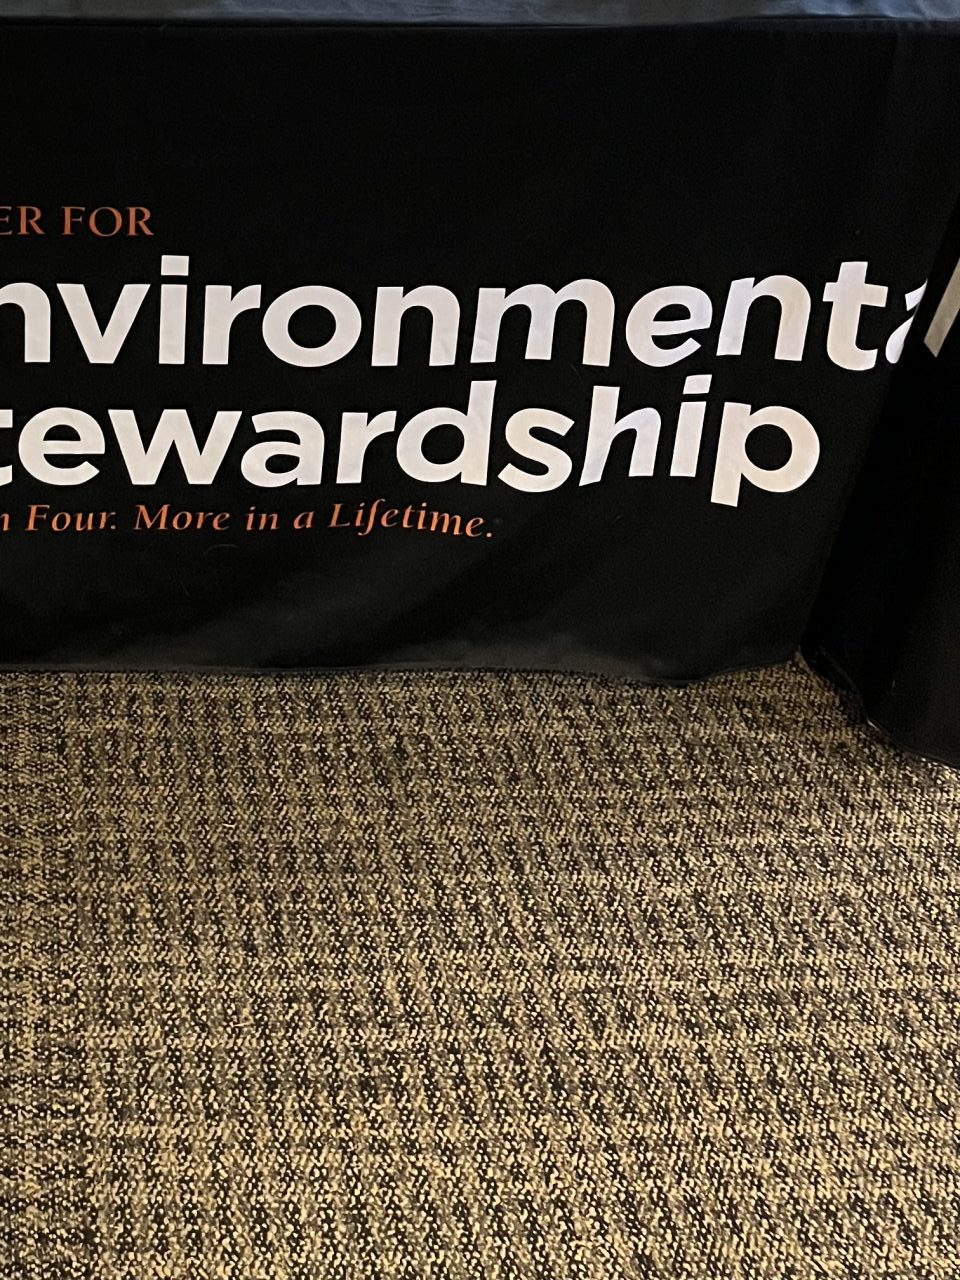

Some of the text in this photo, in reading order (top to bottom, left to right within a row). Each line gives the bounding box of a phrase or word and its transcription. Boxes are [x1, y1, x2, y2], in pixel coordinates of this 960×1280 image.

[62, 206, 154, 237] FOR
[26, 504, 118, 532] Four.
[134, 504, 231, 532] More
[245, 506, 278, 531] in
[292, 511, 314, 530] a
[328, 498, 494, 538] Lifetime.
